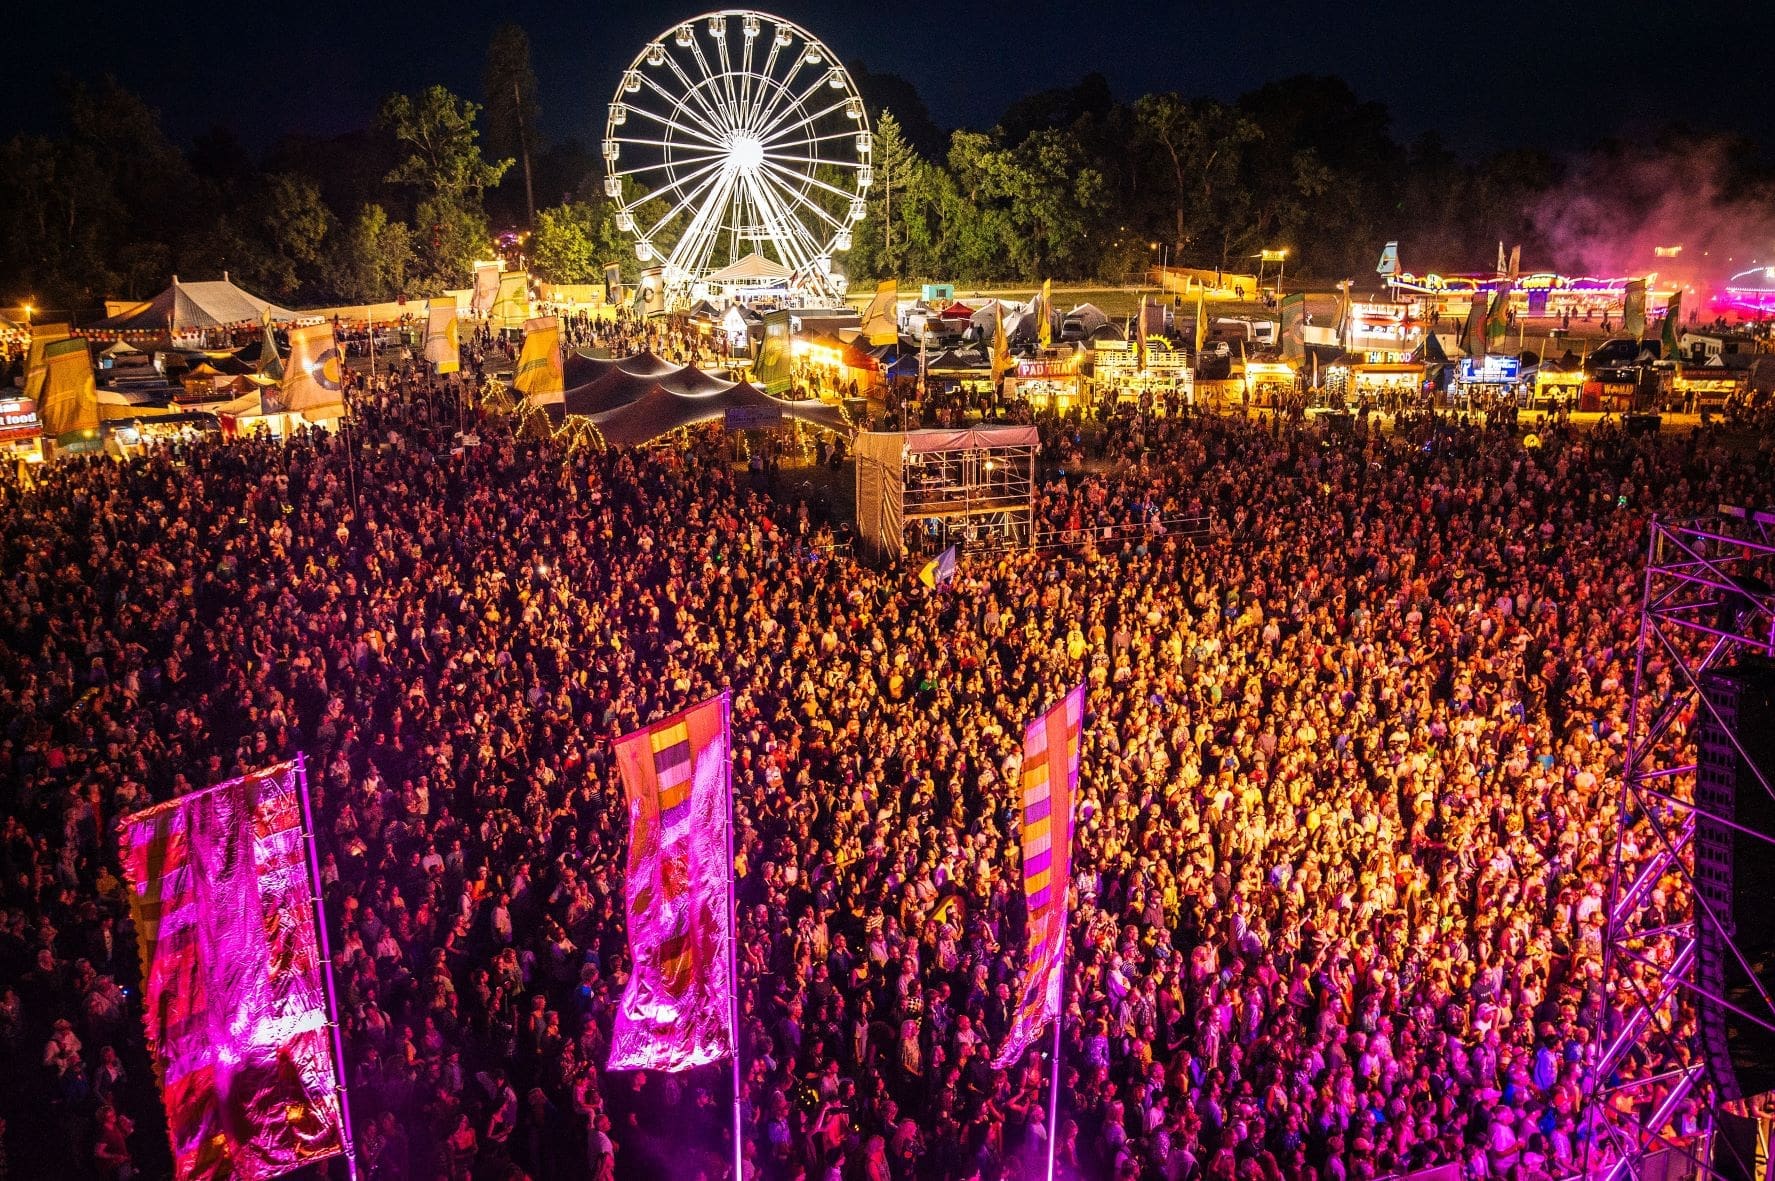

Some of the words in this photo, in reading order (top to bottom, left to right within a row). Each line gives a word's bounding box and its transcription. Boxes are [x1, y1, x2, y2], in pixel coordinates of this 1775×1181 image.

[1097, 350, 1181, 366] Mexcan
[1364, 351, 1384, 363] THAI
[1387, 351, 1412, 363] FOOD
[1022, 364, 1044, 376] PAD
[1046, 363, 1072, 375] THAI
[6, 411, 37, 425] food
